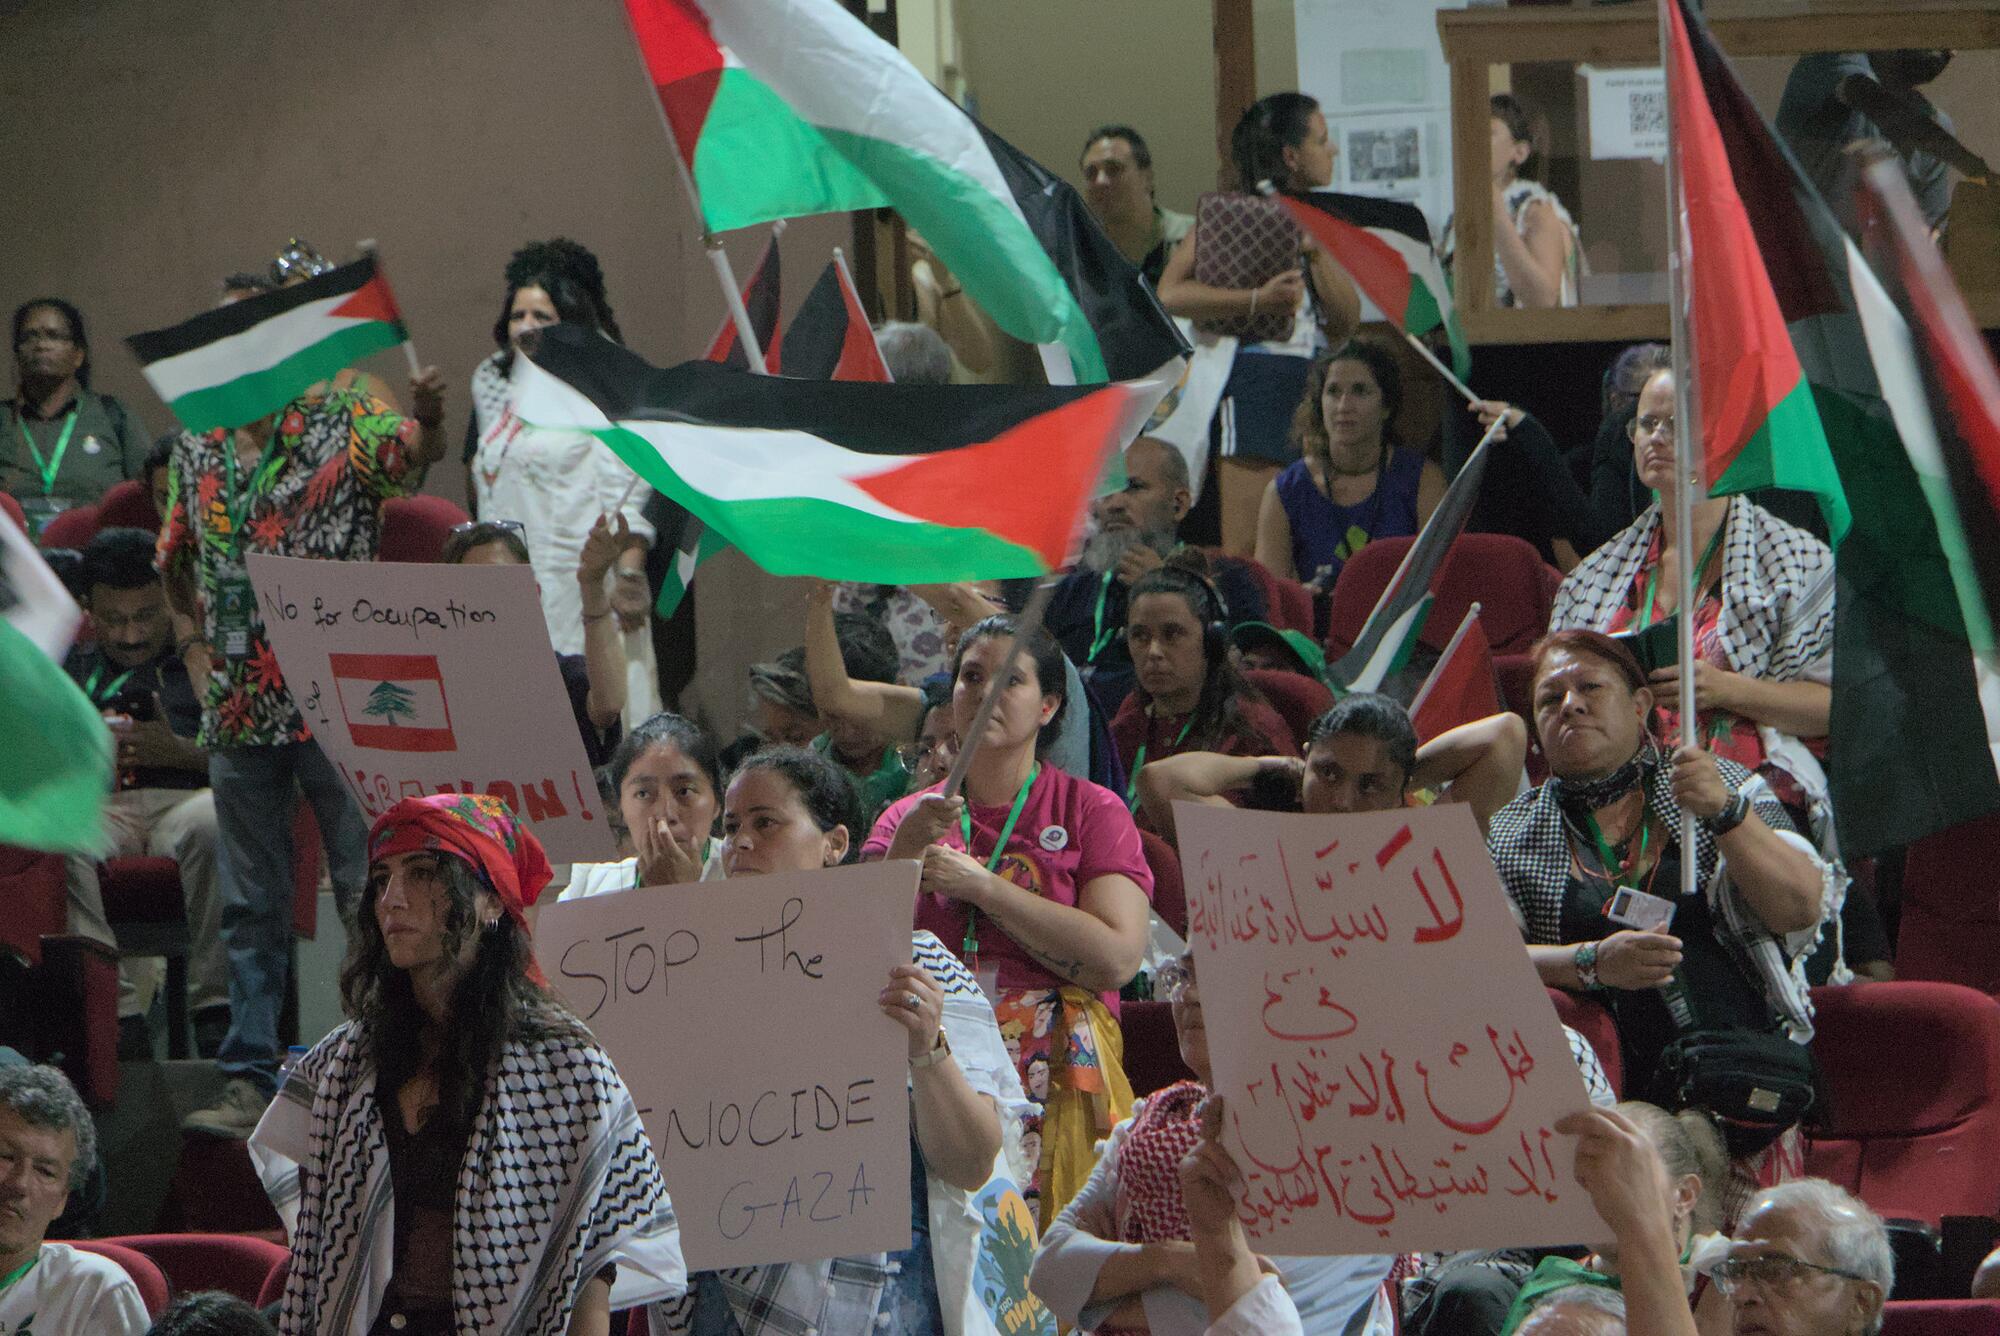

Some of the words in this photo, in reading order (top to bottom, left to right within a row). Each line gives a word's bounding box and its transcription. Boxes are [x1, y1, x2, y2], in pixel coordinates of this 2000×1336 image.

[264, 584, 298, 621] No
[313, 597, 341, 632] for
[352, 599, 496, 639] Occupation
[560, 926, 699, 1020] STOP
[638, 1080, 875, 1159] NOCIDE
[718, 1162, 875, 1240] GAZA
